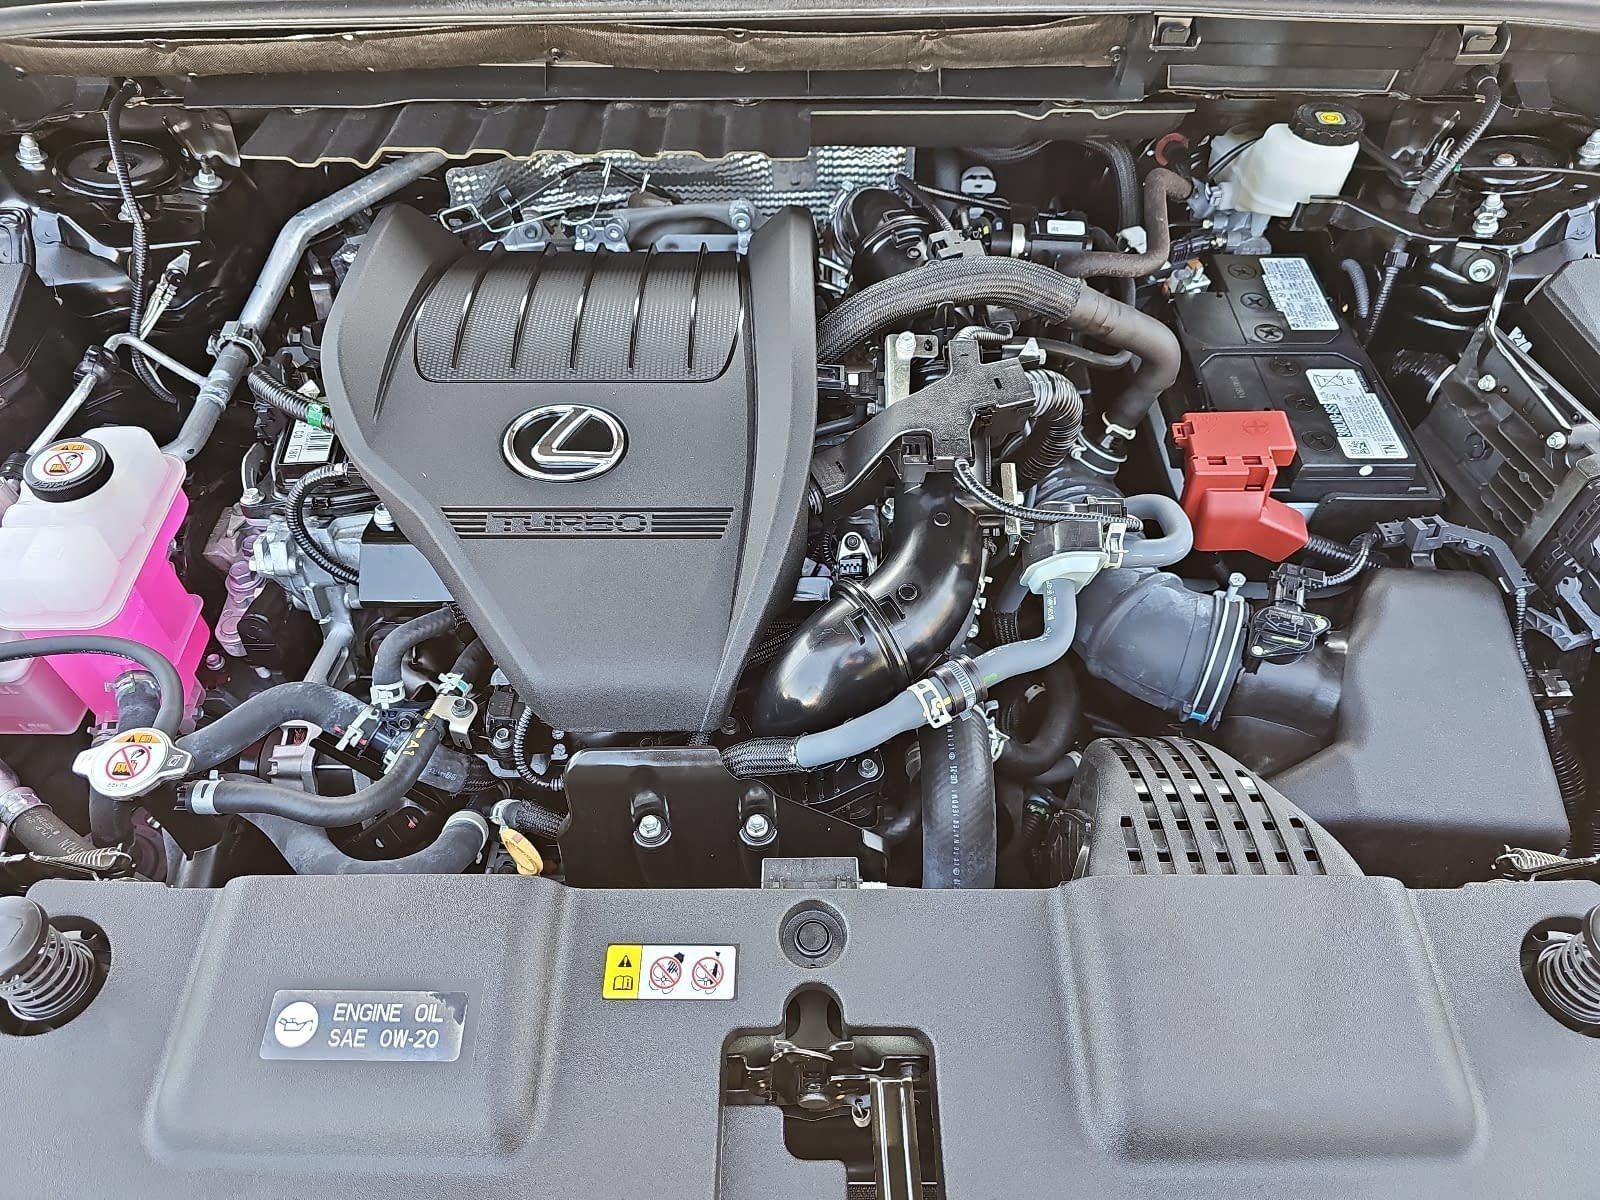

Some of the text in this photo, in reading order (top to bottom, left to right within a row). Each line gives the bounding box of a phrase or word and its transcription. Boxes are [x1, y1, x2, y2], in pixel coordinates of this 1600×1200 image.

[488, 512, 647, 533] TURBO
[333, 1003, 444, 1023] ENGINE OIL
[327, 1028, 439, 1049] SAE 0W-20
